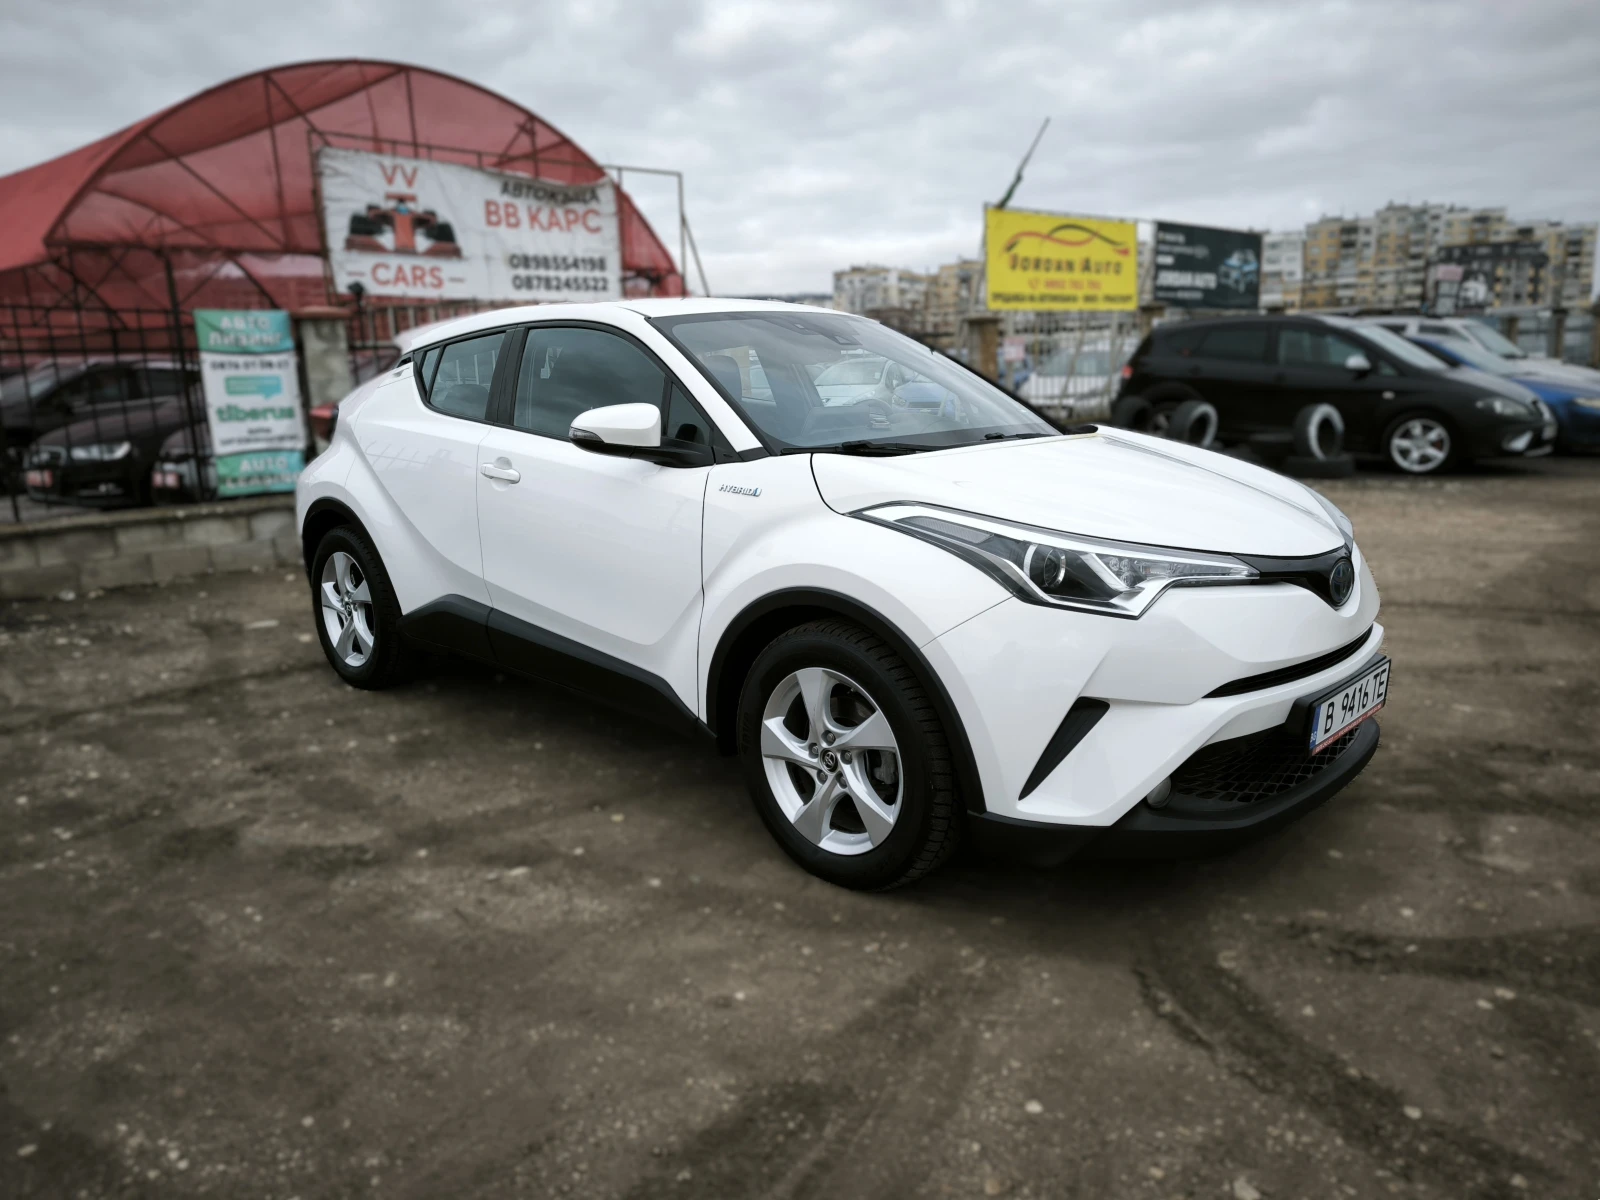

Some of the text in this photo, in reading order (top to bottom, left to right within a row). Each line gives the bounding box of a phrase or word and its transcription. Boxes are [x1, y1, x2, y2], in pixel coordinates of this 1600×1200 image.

[379, 162, 418, 188] VV
[527, 203, 603, 233] КАРС
[371, 262, 445, 289] CARS
[240, 456, 288, 473] AUTO
[719, 484, 756, 497] HYBRID
[1341, 679, 1370, 724] 9416
